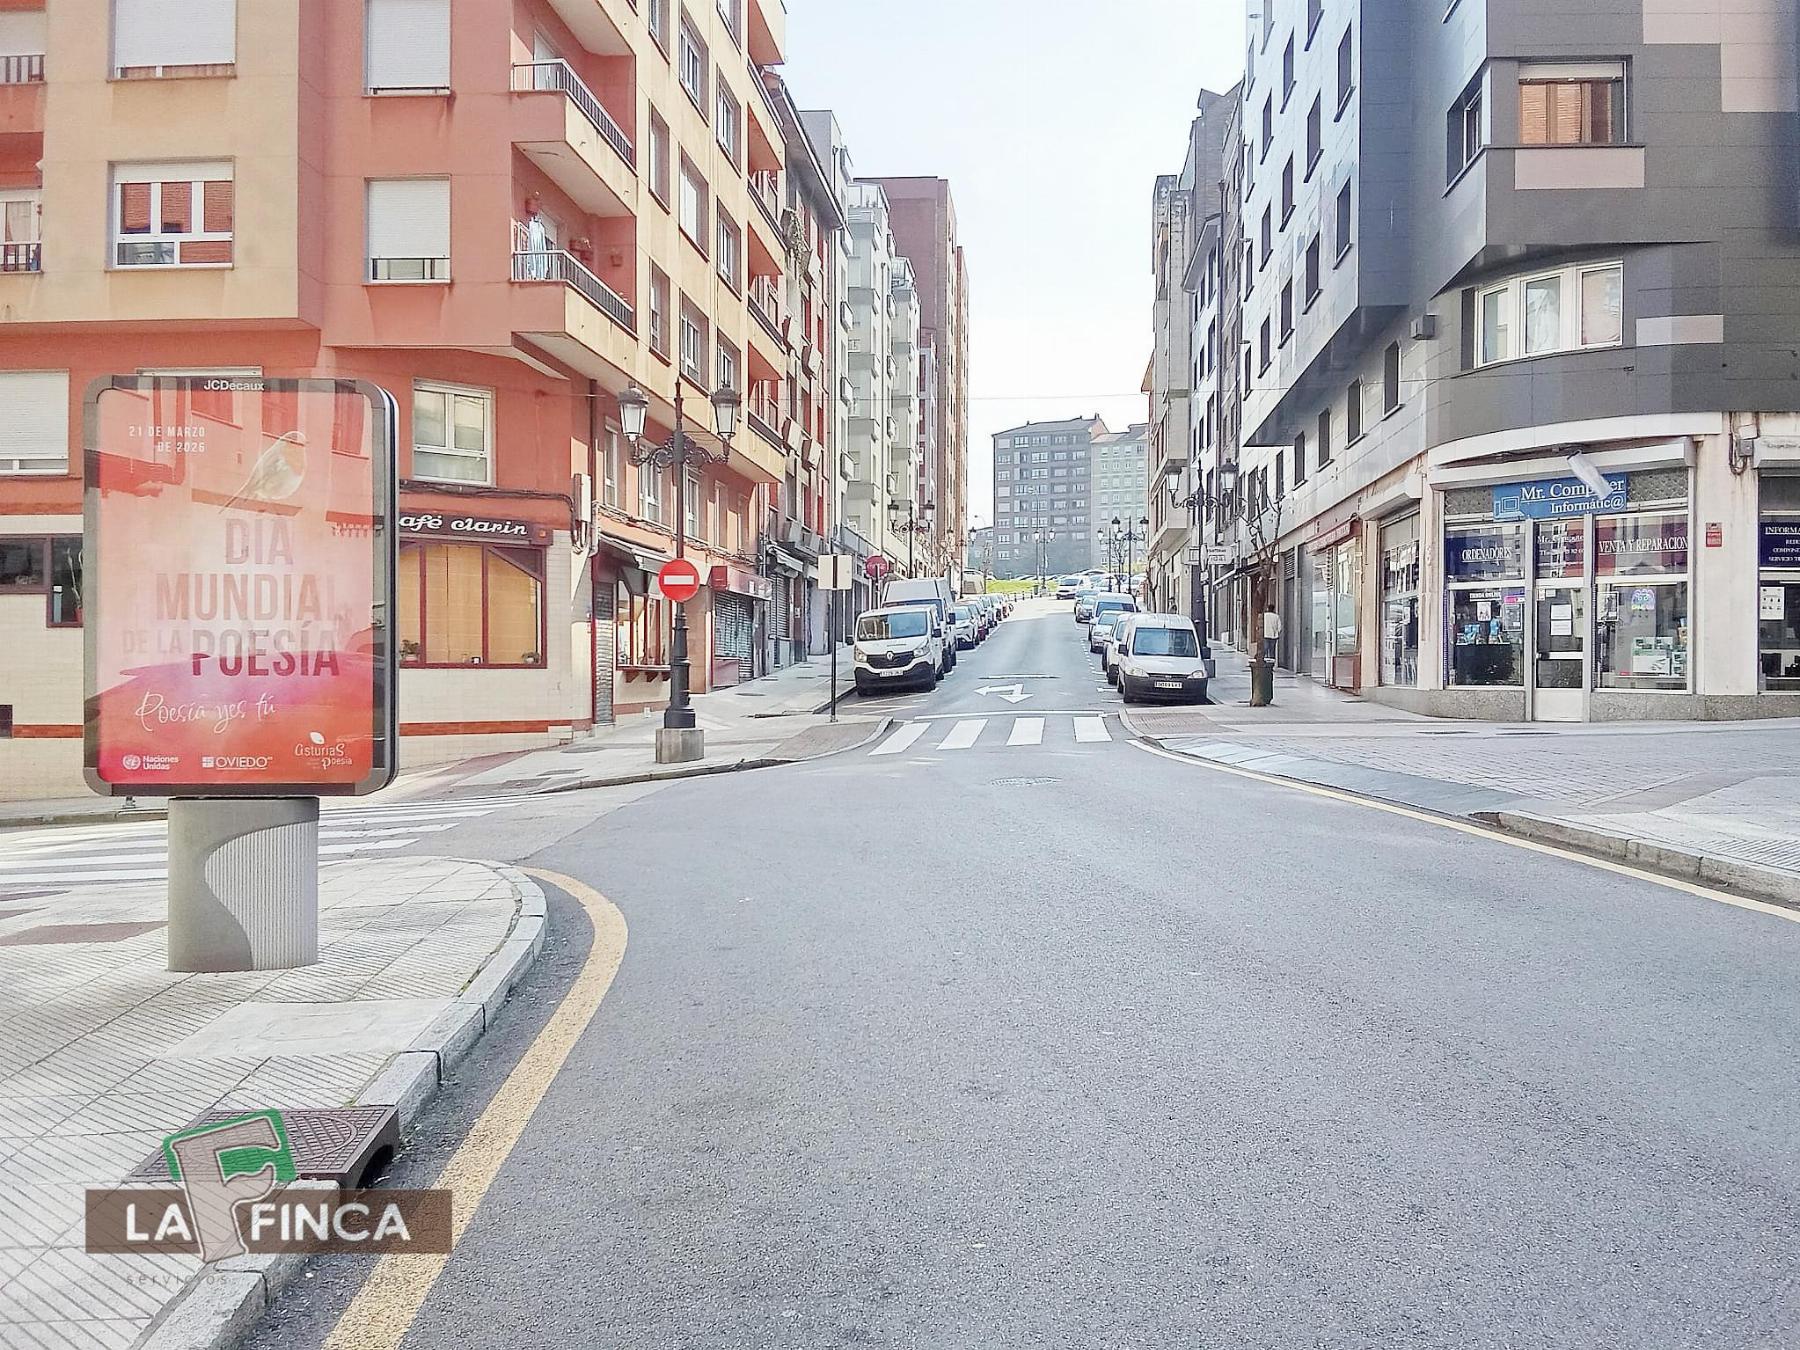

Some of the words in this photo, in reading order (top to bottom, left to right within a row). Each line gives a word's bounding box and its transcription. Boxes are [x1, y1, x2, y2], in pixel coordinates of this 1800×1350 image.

[203, 380, 265, 391] JCDecaux
[128, 426, 142, 437] 21
[148, 426, 162, 437] DE
[167, 426, 205, 437] MARZO
[157, 442, 171, 453] DE
[1520, 486, 1546, 500] Mr.
[1549, 479, 1624, 499] Comper
[1550, 495, 1624, 513] Informátic@
[399, 514, 443, 532] afé
[1598, 540, 1626, 553] VENTA
[1628, 539, 1635, 551] Y
[1461, 546, 1513, 561] ORDENADORES
[156, 573, 341, 621] MUNDIAL
[157, 629, 183, 653] LA
[191, 620, 341, 677] POESÍA
[135, 691, 206, 732] Poesía
[214, 700, 248, 734] yes
[256, 692, 276, 721] tú
[143, 755, 179, 763] Naciones
[143, 762, 170, 770] Unidas
[216, 757, 267, 768] OVIEDO
